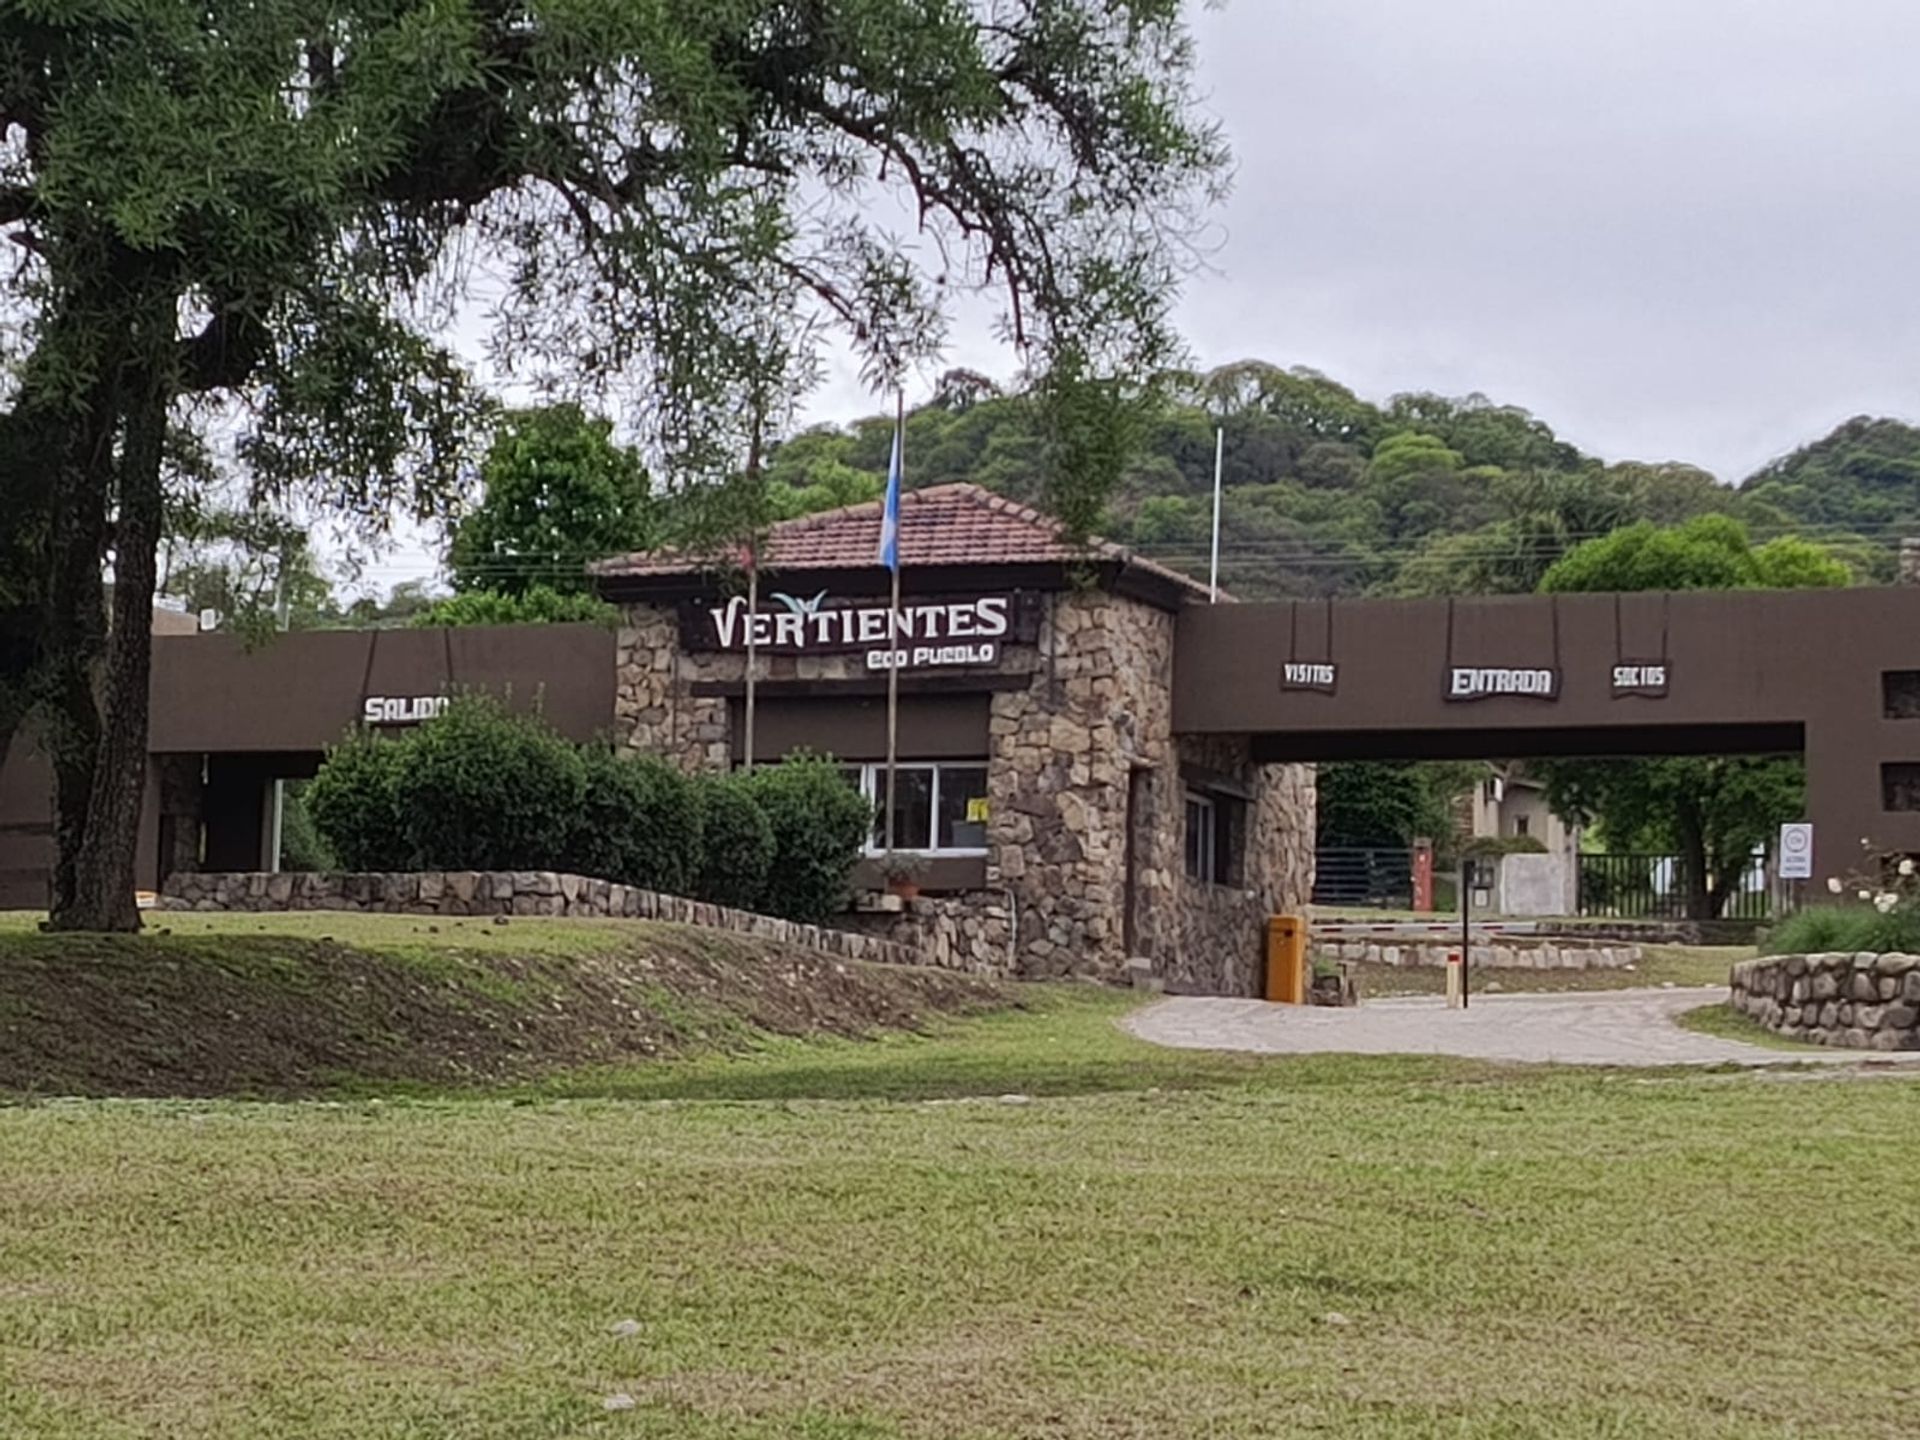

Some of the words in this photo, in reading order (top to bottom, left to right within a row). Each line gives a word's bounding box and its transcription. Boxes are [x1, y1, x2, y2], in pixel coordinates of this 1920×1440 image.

[709, 595, 1008, 648] VERTIENTES
[913, 644, 994, 665] PUEBLO
[1284, 664, 1334, 683] VISITAS
[1451, 669, 1552, 694] ENTRADA
[1613, 666, 1665, 687] SOCIOS
